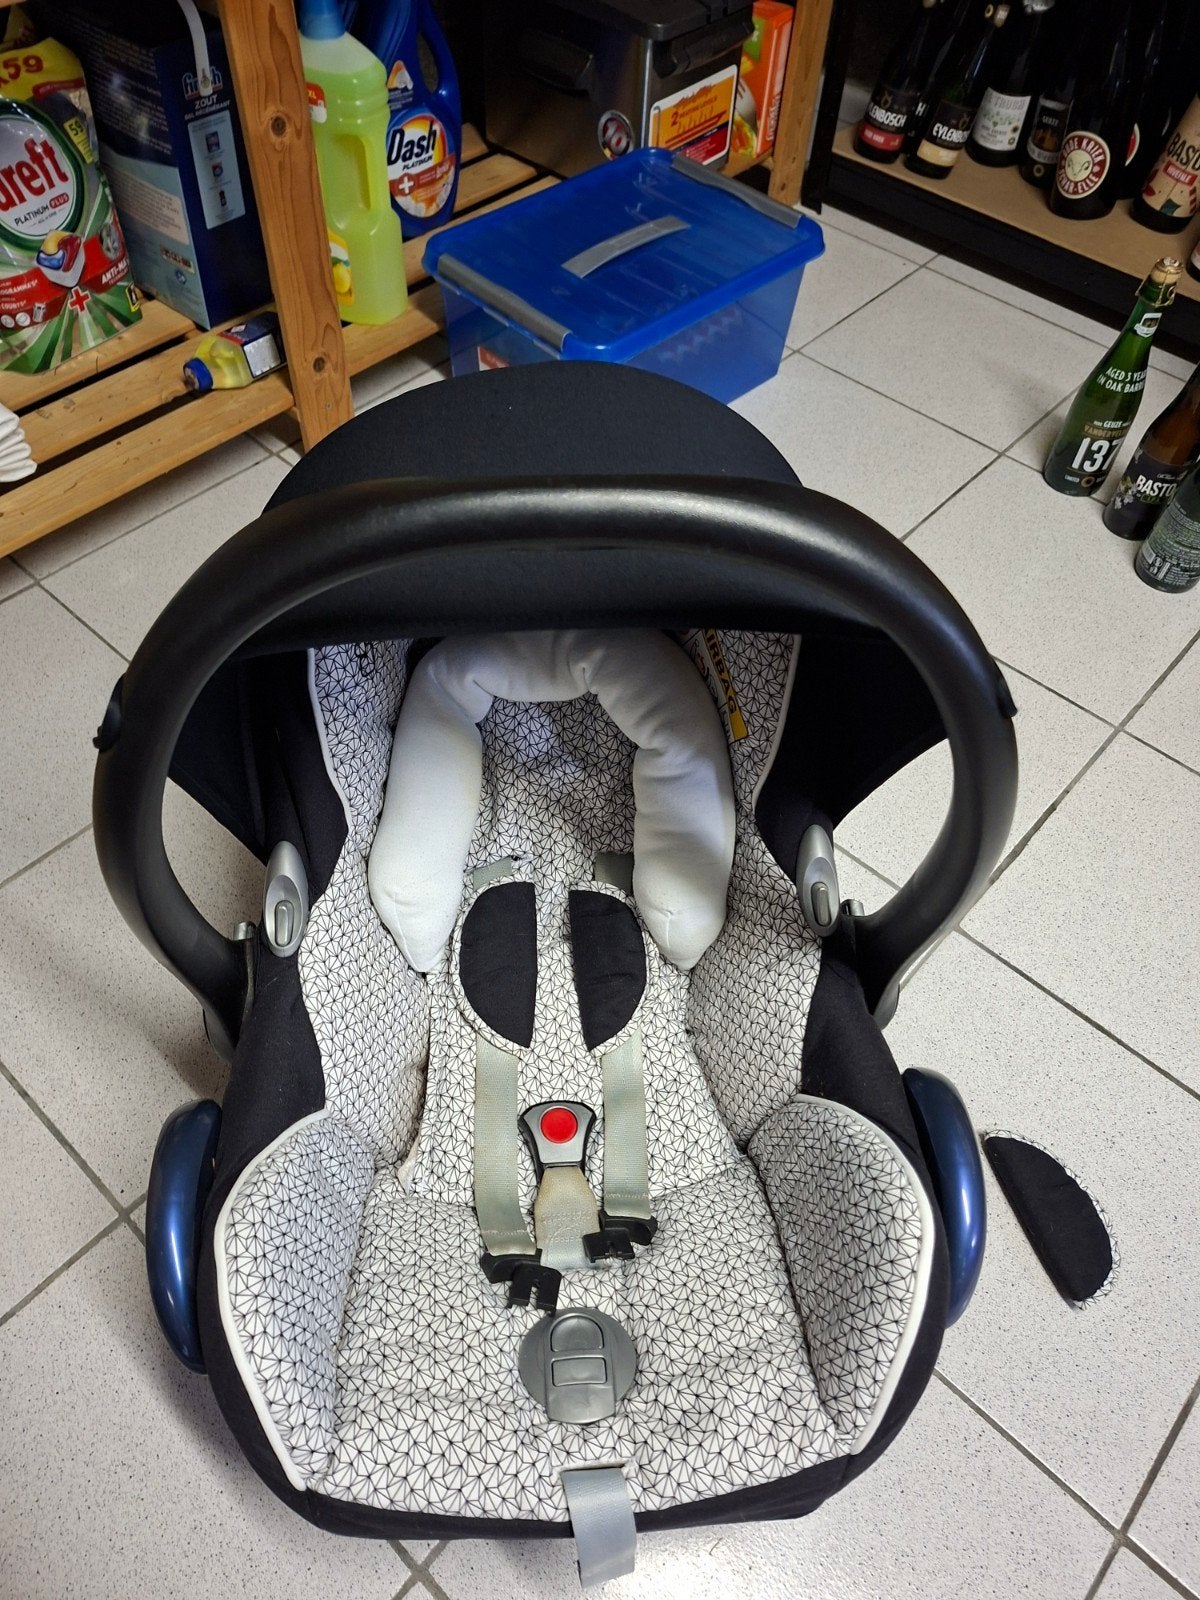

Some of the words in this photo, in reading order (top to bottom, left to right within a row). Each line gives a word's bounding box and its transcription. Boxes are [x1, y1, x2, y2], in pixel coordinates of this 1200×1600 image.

[194, 95, 218, 110] ZOUT
[670, 110, 679, 128] 2
[387, 119, 437, 166] Dash
[1081, 138, 1105, 164] KRIEK
[402, 155, 433, 171] PLATINUM
[14, 204, 49, 227] PLATINUM
[50, 194, 69, 208] PLUS
[1105, 366, 1126, 381] AGED
[1125, 372, 1132, 382] 3
[1096, 374, 1105, 385] IN
[1105, 380, 1122, 393] OAK
[1103, 420, 1123, 428] GEUZE
[1071, 437, 1122, 473] 137
